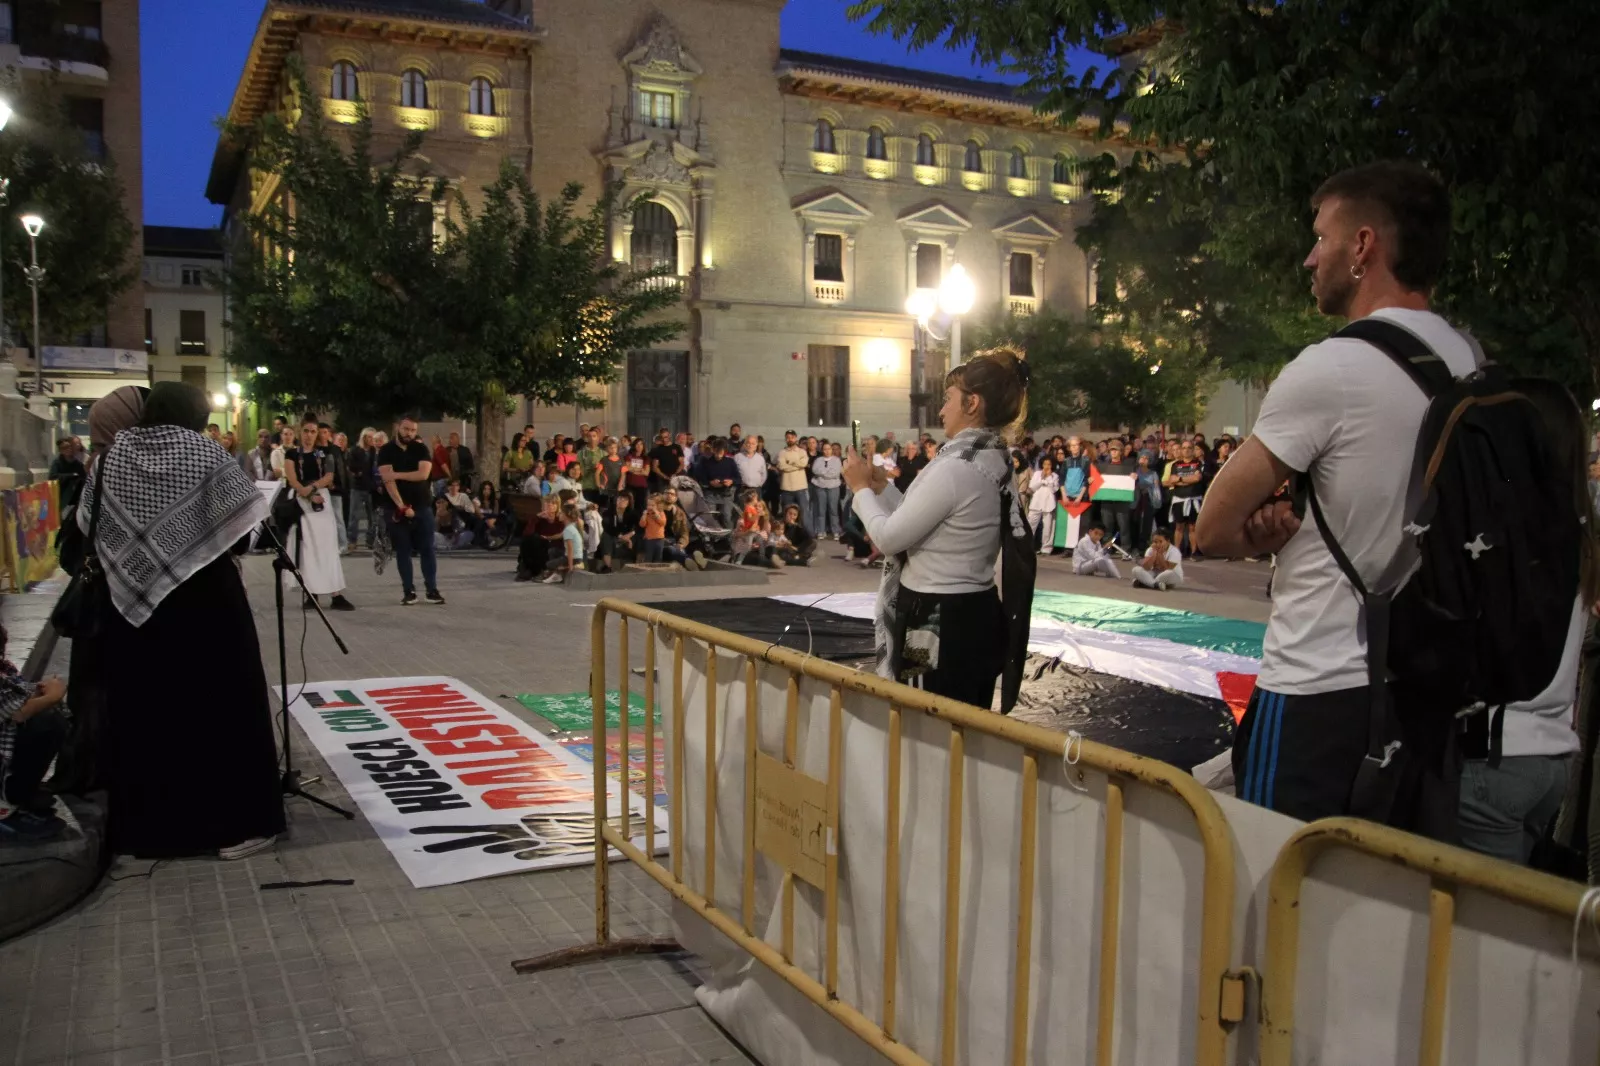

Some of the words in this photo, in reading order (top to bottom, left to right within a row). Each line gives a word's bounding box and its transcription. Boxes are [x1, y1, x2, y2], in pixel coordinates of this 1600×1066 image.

[15, 380, 71, 395] ENT
[318, 708, 389, 733] CON
[365, 683, 615, 810] PALESTINA
[346, 737, 471, 814] HUESCA
